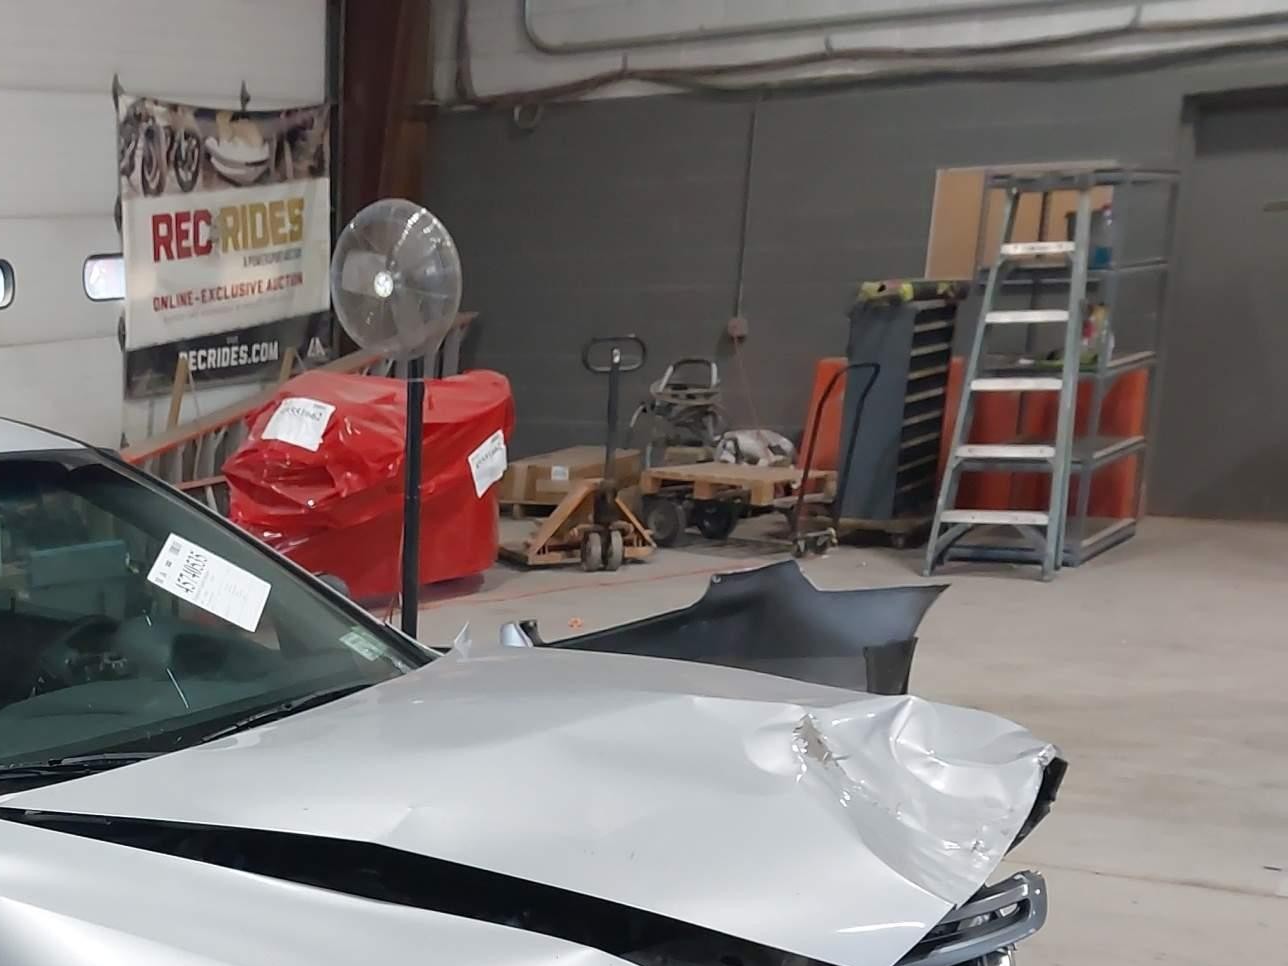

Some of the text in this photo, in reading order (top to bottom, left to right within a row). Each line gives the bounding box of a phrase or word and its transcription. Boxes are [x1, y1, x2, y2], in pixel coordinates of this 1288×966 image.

[152, 198, 304, 262] REC RIDES
[153, 280, 263, 311] ONLINE-EXCLUSIVE
[266, 272, 303, 291] AUCTION
